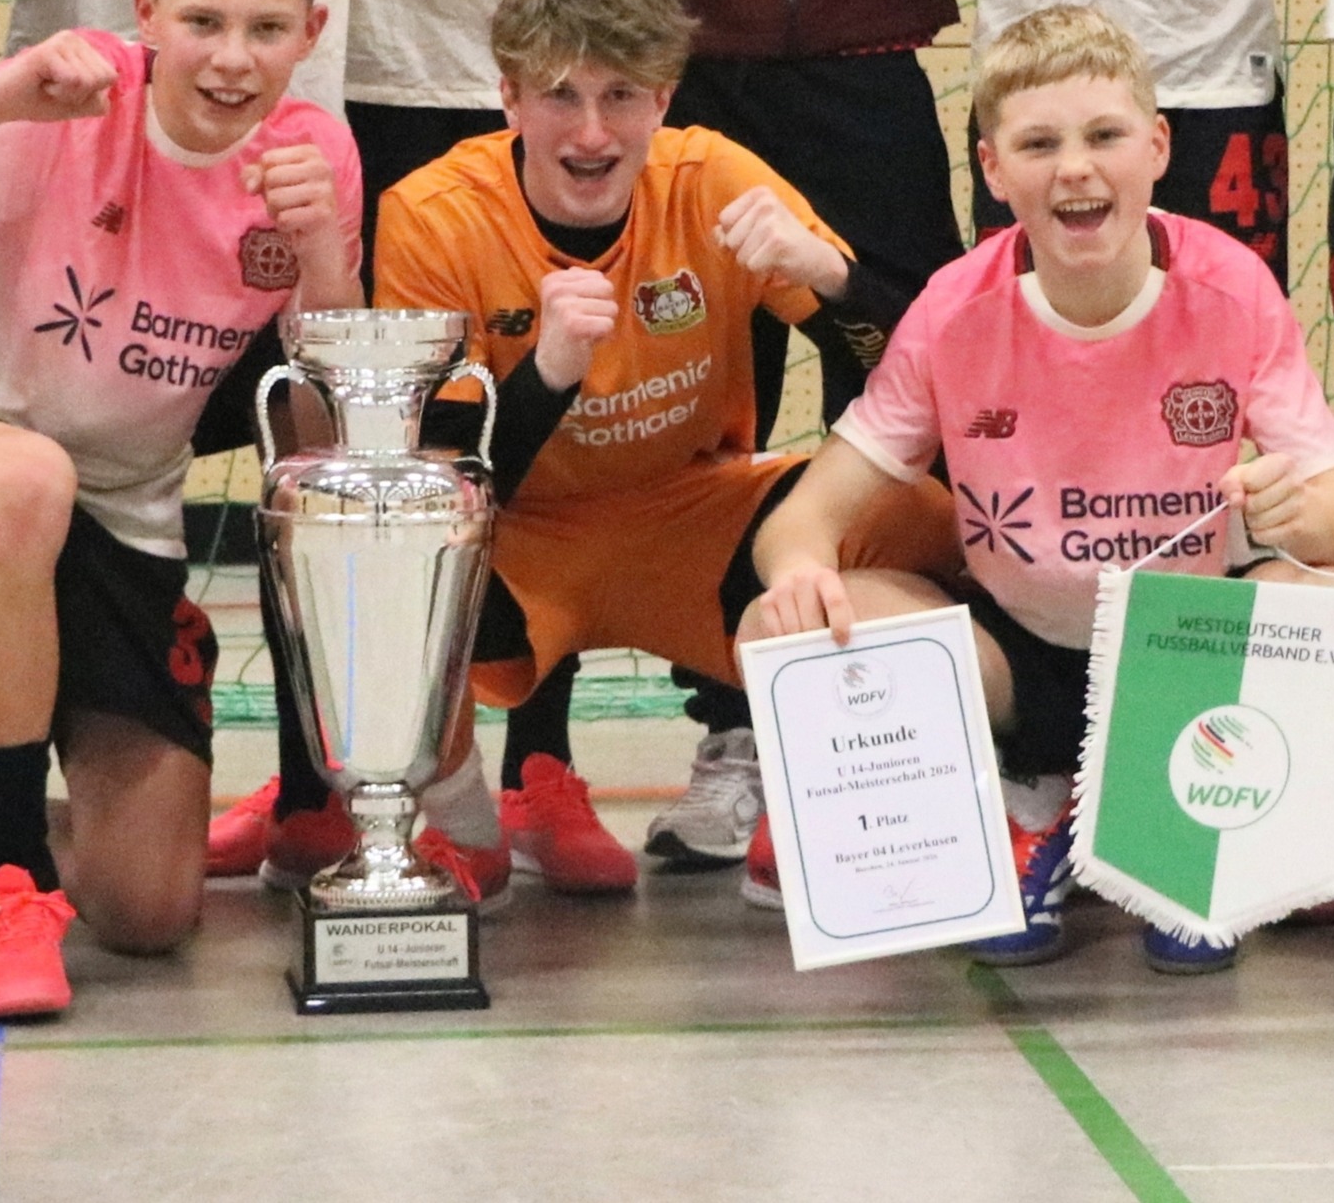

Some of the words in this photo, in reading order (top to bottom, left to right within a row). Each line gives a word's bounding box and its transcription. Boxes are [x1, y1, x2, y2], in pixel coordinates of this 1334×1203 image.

[131, 300, 255, 351] Barmen
[119, 343, 220, 388] Gotha
[1061, 530, 1216, 563] Gothaer
[1178, 615, 1322, 643] WESTDEUTSCHER
[1147, 633, 1310, 663] FUSSBALLVERBAND
[847, 689, 887, 706] WDFV
[831, 725, 917, 754] Urkunde
[806, 770, 926, 799] Futsal-Meisterschaft
[1187, 783, 1271, 811] WDFV
[876, 813, 909, 828] Platz
[835, 851, 869, 865] Bayer
[873, 845, 887, 856] 04
[890, 835, 959, 855] Leverkusen
[326, 920, 457, 936] WANDERPOKAL
